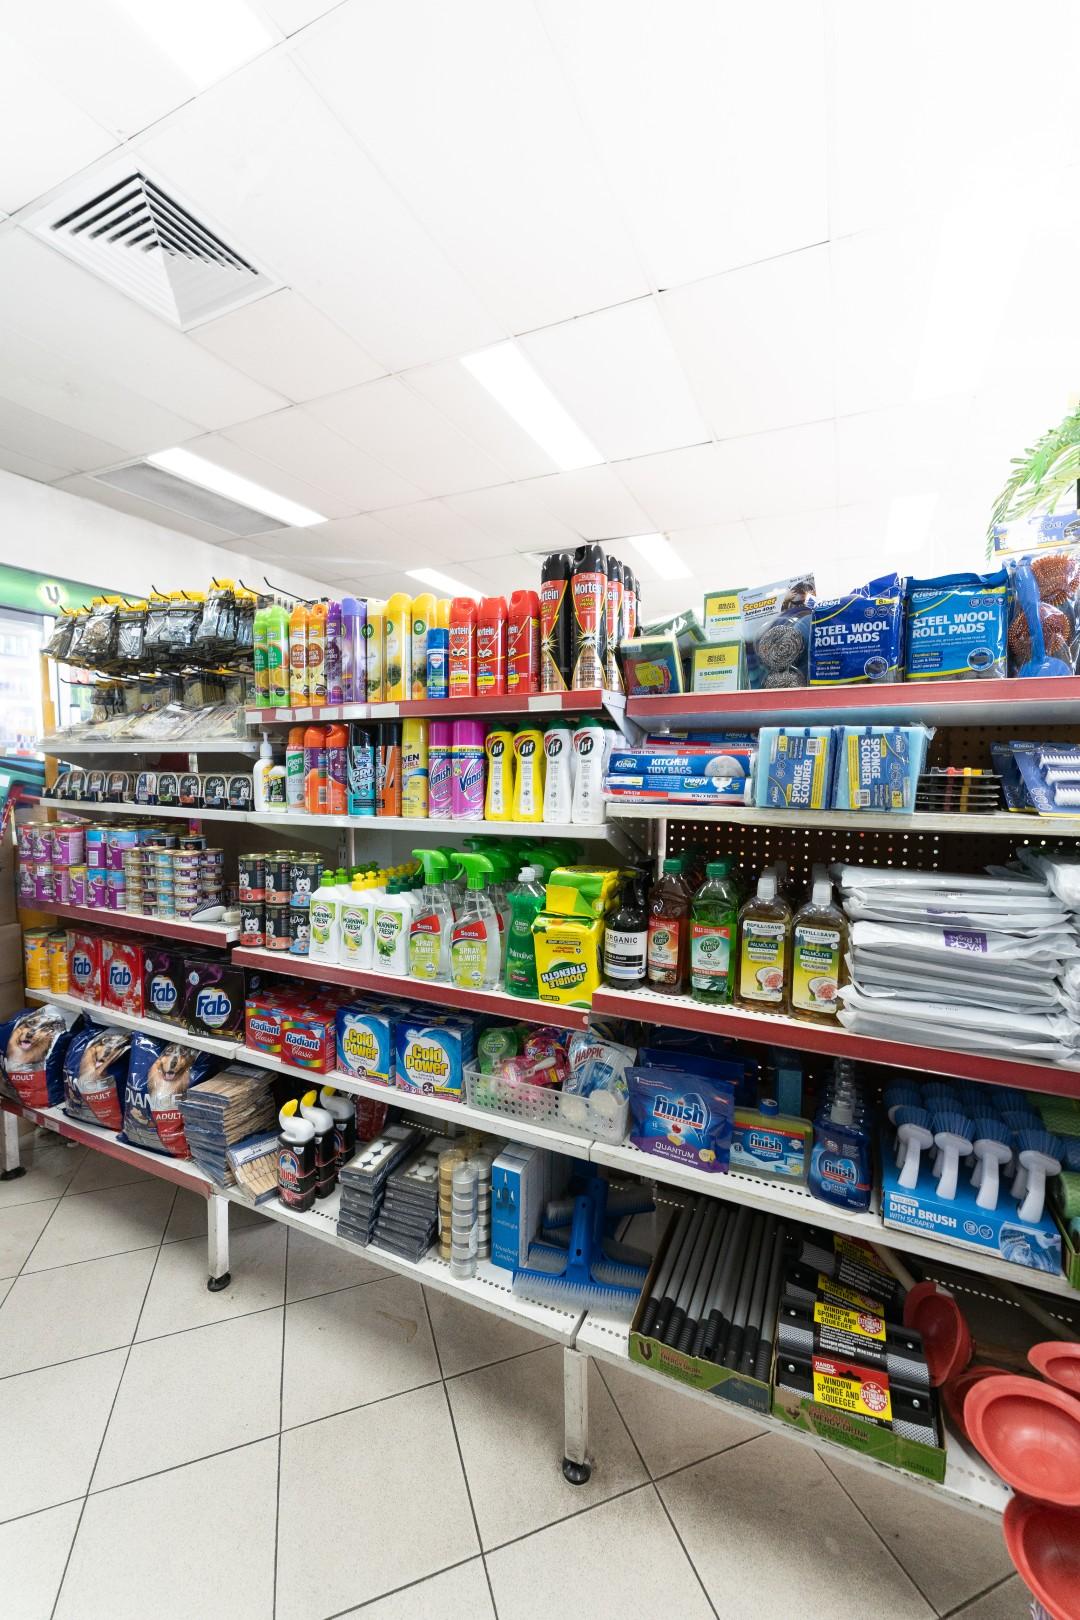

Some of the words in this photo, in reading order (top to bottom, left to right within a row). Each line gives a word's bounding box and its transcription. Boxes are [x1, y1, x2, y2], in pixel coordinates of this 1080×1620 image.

[743, 597, 777, 612] Scourer
[912, 616, 951, 629] STEEL
[953, 610, 997, 623] WOOL
[814, 624, 849, 637] STEEL
[851, 620, 890, 633] WOOL
[912, 625, 946, 639] ROLL
[948, 622, 986, 635] PADS
[814, 635, 845, 648] ROLL
[847, 632, 880, 644] PADS
[522, 742, 534, 755] Jif
[581, 742, 592, 754] Jif
[401, 753, 420, 763] VEN
[650, 757, 689, 766] KITCHEN
[860, 738, 872, 786] SCOURER
[870, 738, 881, 779] SPONGE
[430, 764, 452, 791] Vanish
[646, 766, 667, 774] TIDY
[667, 766, 692, 775] BAGS
[791, 764, 803, 804] SPONGE
[800, 759, 813, 804] SCOURER
[313, 916, 329, 925] FRESH
[345, 923, 361, 931] FRESH
[376, 920, 399, 930] MORNING
[378, 926, 395, 936] FRESH
[605, 932, 638, 944] ORGANIC
[459, 947, 480, 955] SPRAY
[463, 954, 481, 962] WIPE
[72, 957, 91, 976] Fab
[541, 964, 587, 984] STRENGTH
[109, 966, 132, 986] Fab
[549, 973, 584, 988] DOUBLE
[150, 984, 178, 1003] Fab
[196, 995, 232, 1018] Fab
[250, 1018, 281, 1036] Radiant
[285, 1031, 321, 1051] Radiant
[348, 1028, 374, 1049] Cold
[290, 1044, 314, 1060] Classic
[344, 1039, 378, 1061] Power
[411, 1043, 443, 1065] Cold
[405, 1054, 449, 1077] Power
[11, 1073, 36, 1082] ADULT
[85, 1090, 112, 1102] ADULT
[155, 1112, 182, 1121] ADULT
[653, 1094, 706, 1125] finish
[655, 1140, 695, 1160] QUANTUM
[749, 1132, 782, 1152] finish
[823, 1159, 855, 1181] finish
[889, 1202, 916, 1217] DISH
[918, 1208, 957, 1228] BRUSH
[889, 1212, 906, 1221] WITH
[906, 1216, 935, 1230] SCRAPER
[817, 1309, 842, 1321] SPONGE
[843, 1316, 857, 1326] AND
[823, 1304, 850, 1317] WINDOW
[820, 1316, 853, 1330] SQUEEGEE
[823, 1376, 852, 1390] WINDOW
[817, 1383, 844, 1398] SPONGE
[845, 1390, 860, 1401] AND
[821, 1392, 856, 1409] SQUEEGEE
